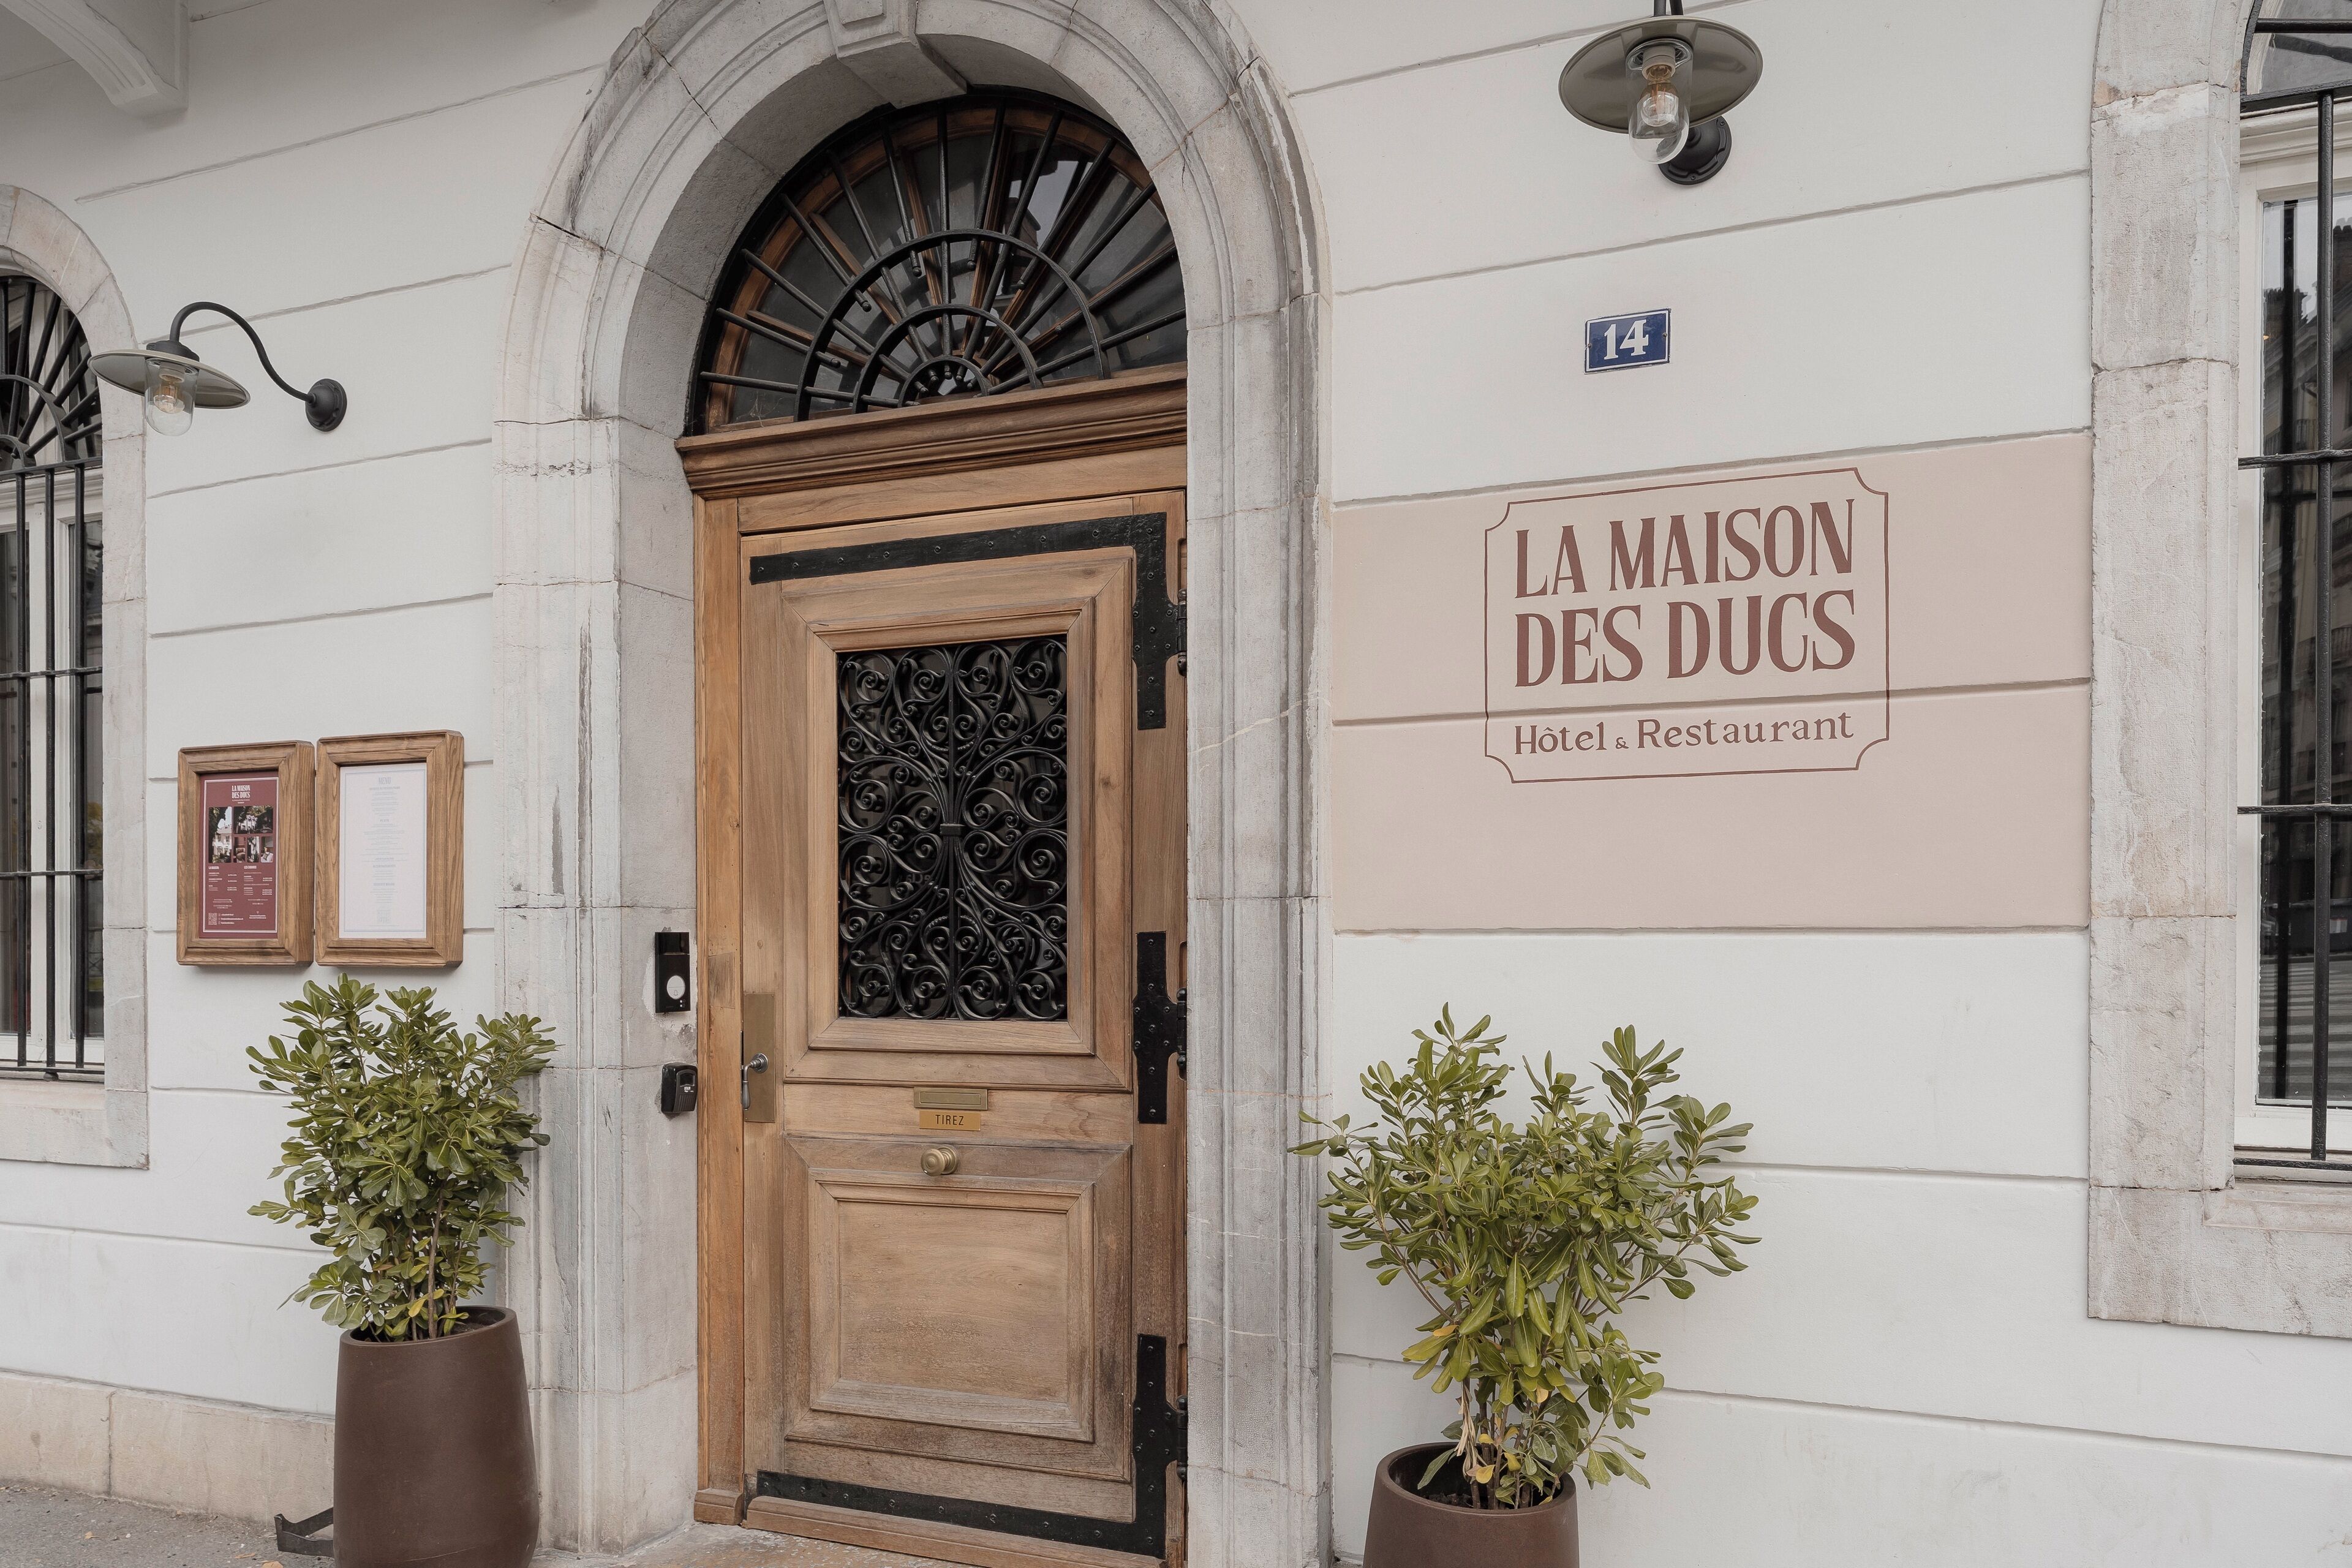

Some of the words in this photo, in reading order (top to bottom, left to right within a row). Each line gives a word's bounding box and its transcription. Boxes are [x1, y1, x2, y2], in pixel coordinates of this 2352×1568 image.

[1604, 319, 1649, 360] 14
[1515, 525, 1588, 598] LA
[1609, 499, 1855, 591] MAISON
[1515, 605, 1643, 687] DES
[1667, 589, 1855, 679] DUCS
[1514, 722, 1607, 755] Hôtel
[1615, 736, 1629, 750] &
[1637, 712, 1854, 750] Restaurant
[935, 1114, 964, 1126] TIREZ
